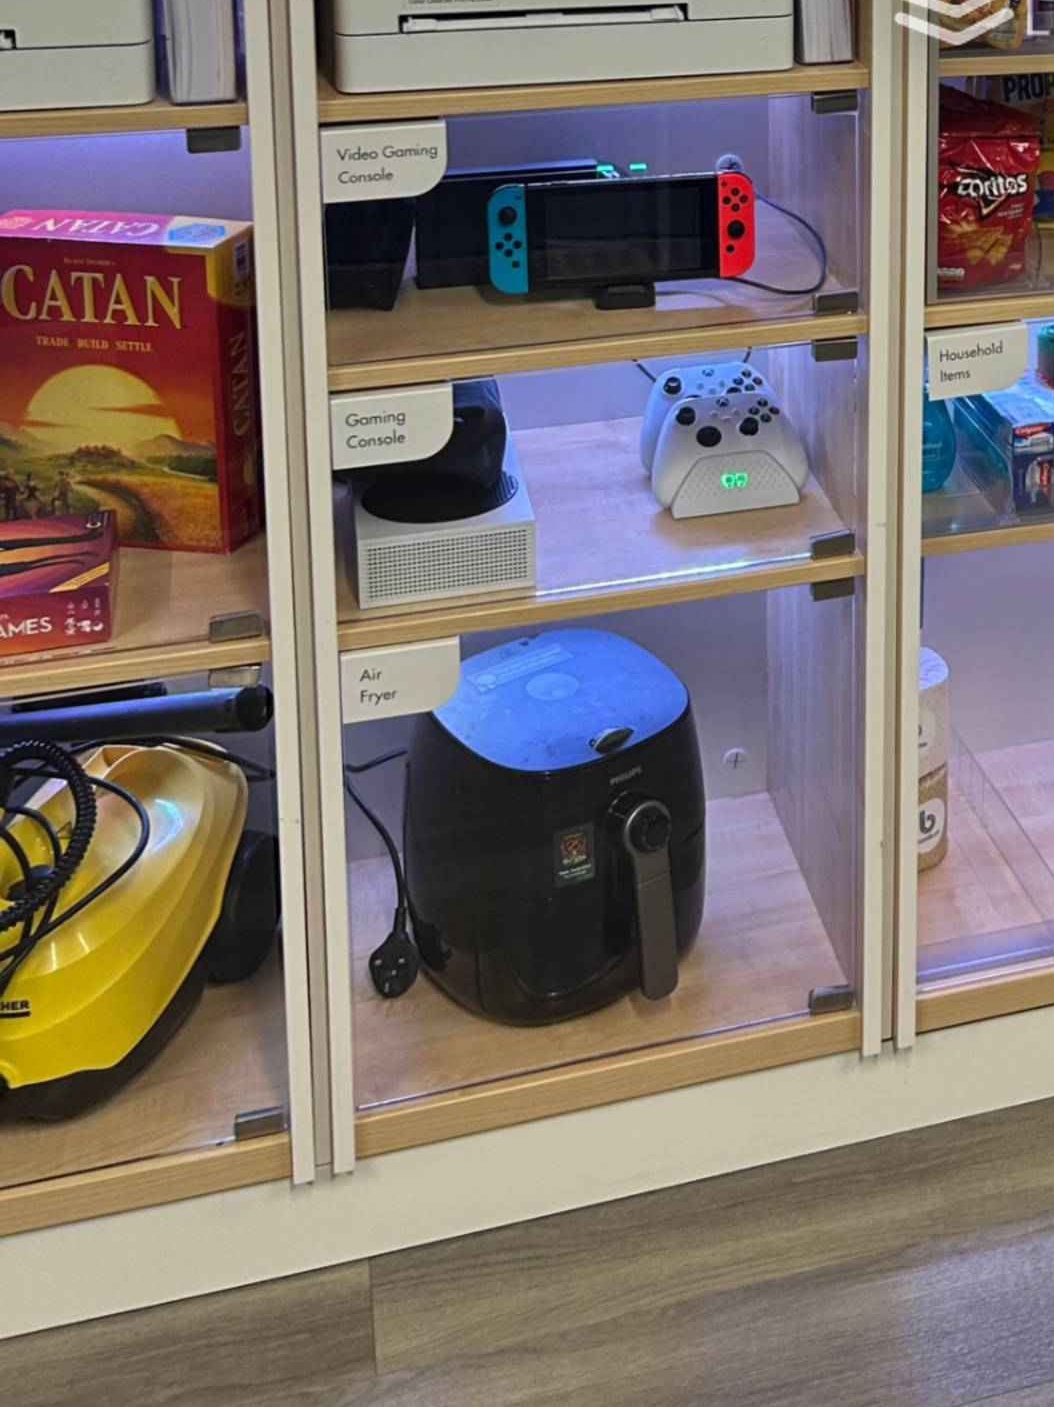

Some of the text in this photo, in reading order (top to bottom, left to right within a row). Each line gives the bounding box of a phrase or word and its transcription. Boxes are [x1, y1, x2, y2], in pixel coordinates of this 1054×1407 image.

[336, 143, 438, 162] Video Gaming
[338, 167, 394, 184] Console
[1, 264, 183, 330] CATAN
[36, 335, 153, 353] TRADE BUILD SETTLE
[938, 340, 1004, 363] Household
[939, 369, 972, 383] Items
[345, 410, 406, 428] Gaming
[346, 429, 406, 449] Console
[0, 617, 53, 639] AMES
[359, 667, 383, 682] Air
[360, 689, 398, 706] Fryer
